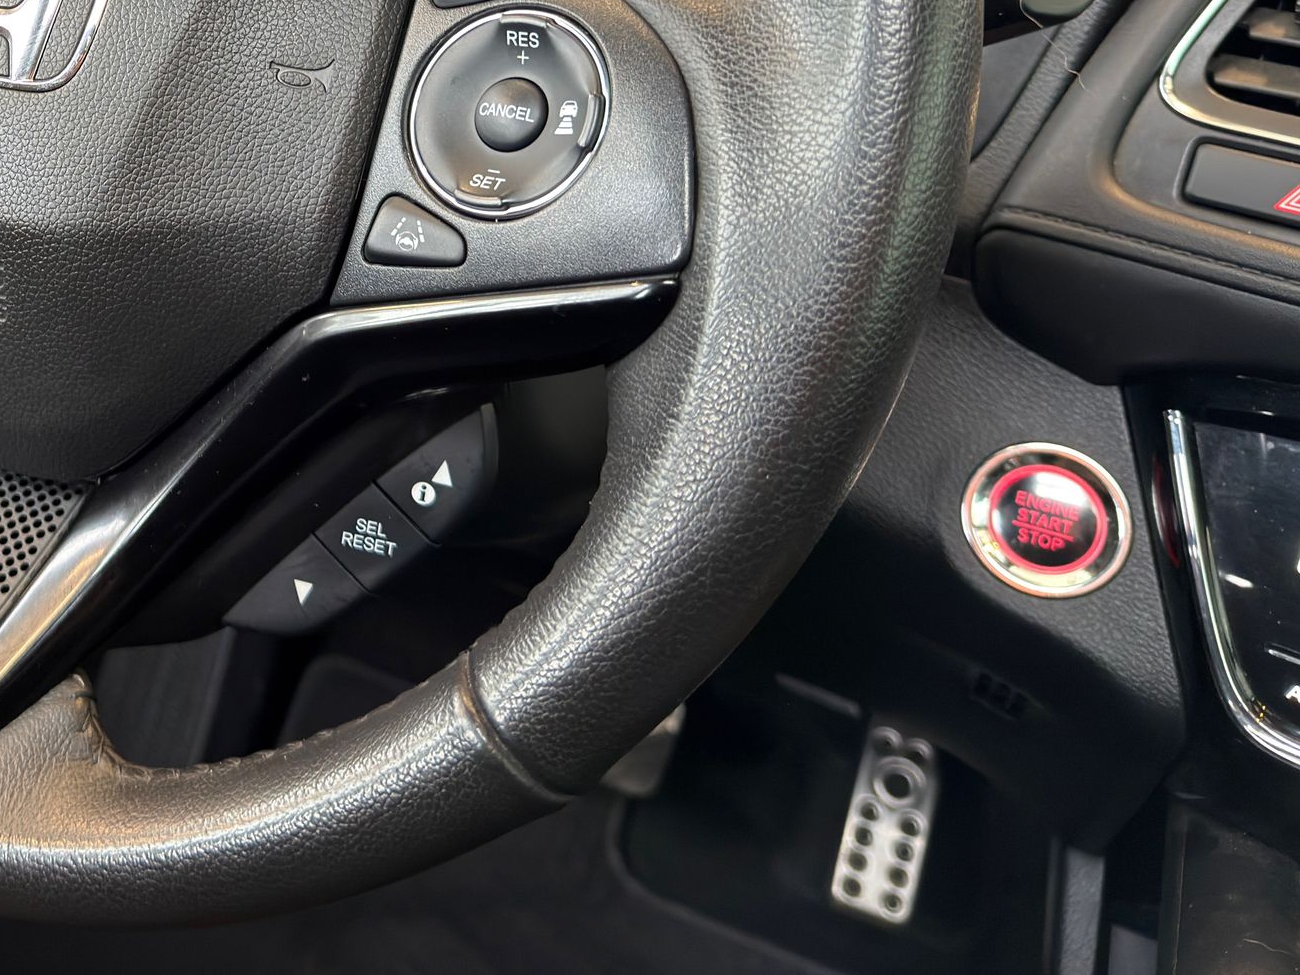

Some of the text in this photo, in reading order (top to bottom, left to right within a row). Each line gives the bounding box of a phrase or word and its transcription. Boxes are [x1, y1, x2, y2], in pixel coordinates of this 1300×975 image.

[506, 29, 540, 49] RES
[478, 101, 536, 124] CANCEL
[469, 174, 506, 192] SET
[1015, 490, 1080, 522] ENGINE
[355, 517, 387, 538] SEL
[1017, 507, 1074, 535] START
[341, 530, 397, 557] RESET
[1017, 527, 1066, 551] STOP
